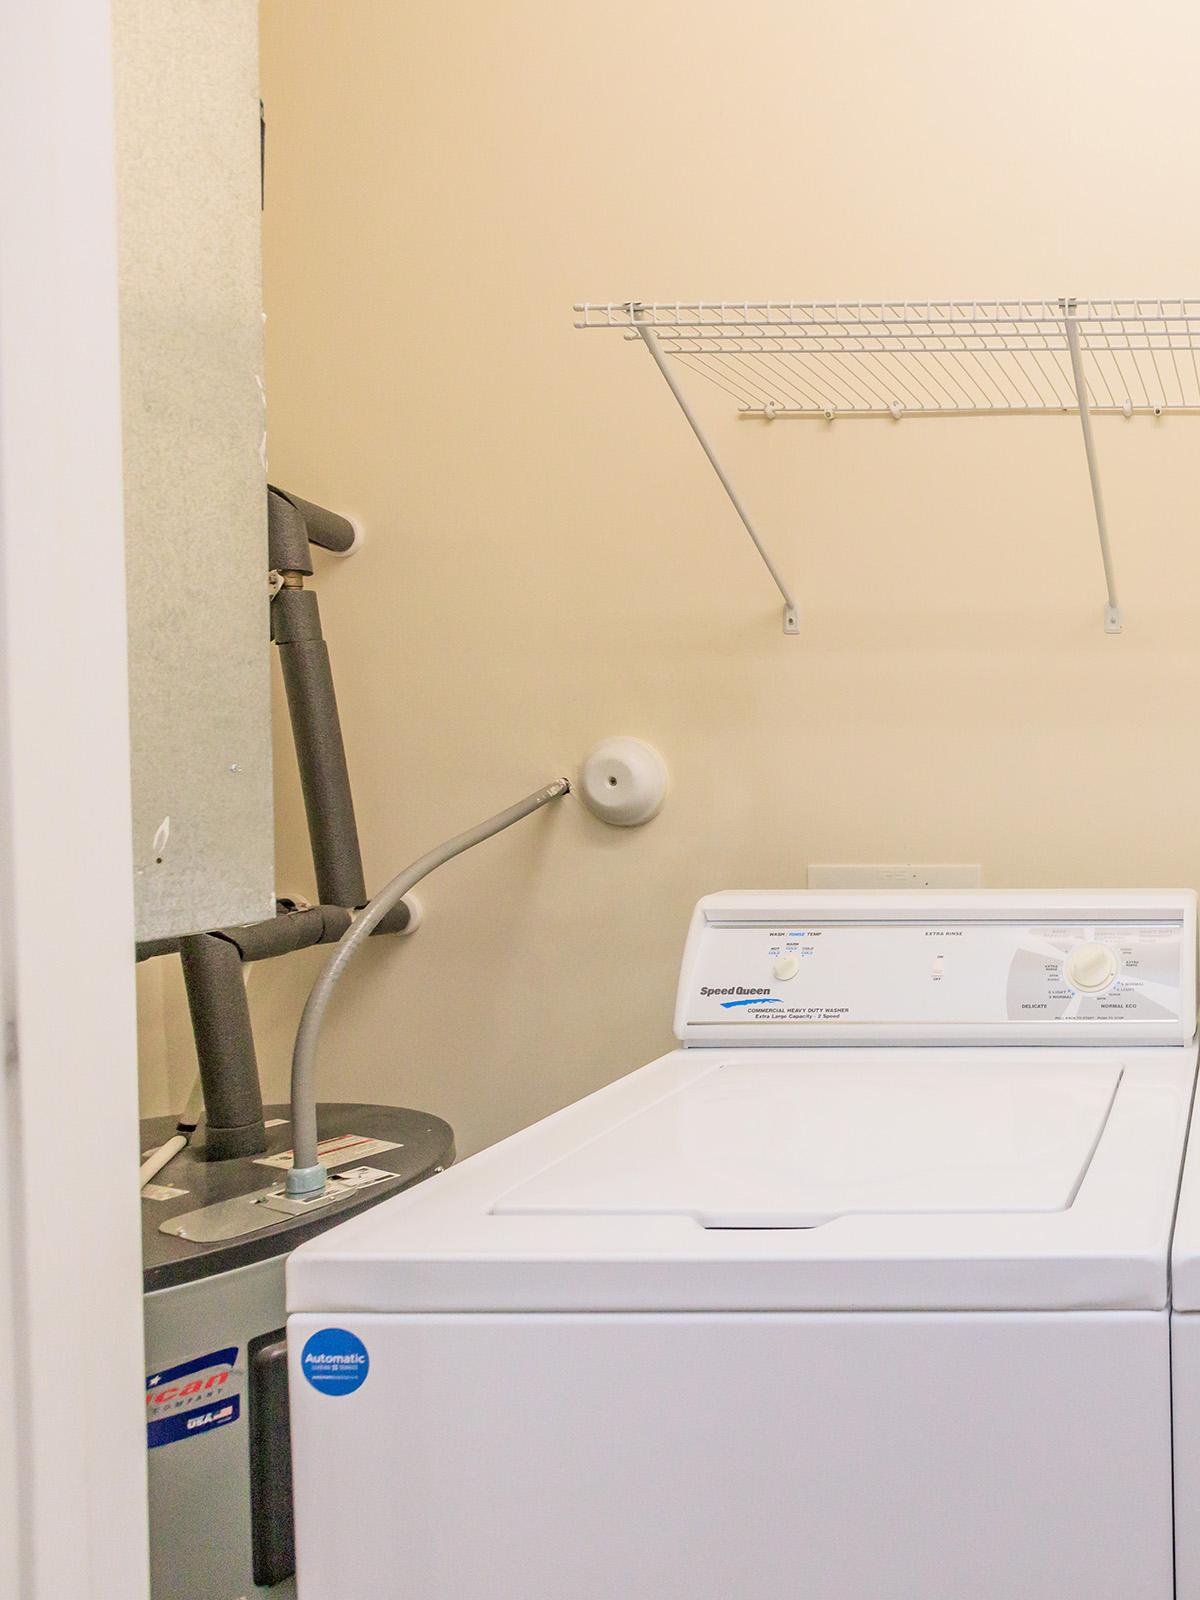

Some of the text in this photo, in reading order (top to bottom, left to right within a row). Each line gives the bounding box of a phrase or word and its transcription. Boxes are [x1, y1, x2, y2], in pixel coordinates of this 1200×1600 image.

[700, 986, 771, 997] Speed Queen
[304, 1352, 366, 1364] Automatic
